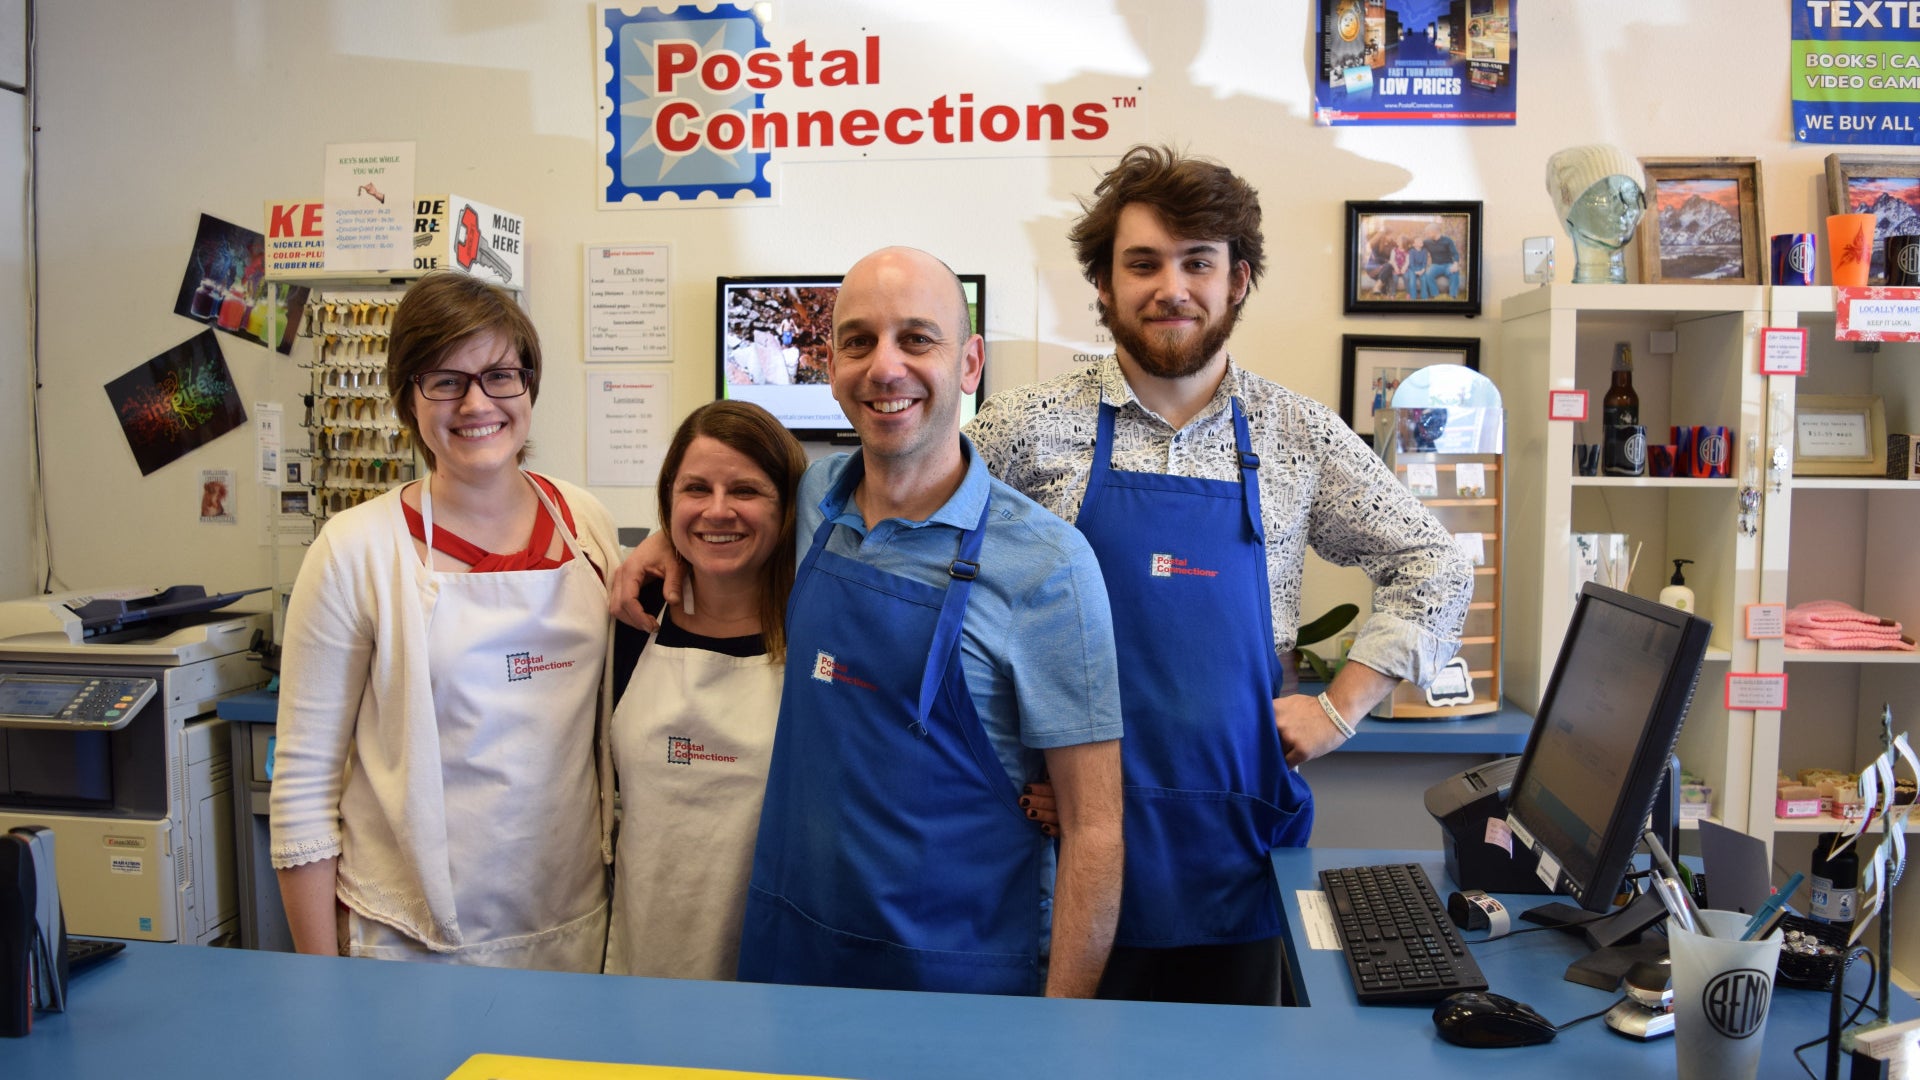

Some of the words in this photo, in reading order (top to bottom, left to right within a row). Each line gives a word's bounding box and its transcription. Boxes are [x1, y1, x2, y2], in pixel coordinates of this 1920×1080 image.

[657, 36, 880, 92] Postal
[1806, 54, 1878, 68] BOOKS
[1388, 68, 1404, 77] FAST
[1406, 68, 1424, 77] TURN
[1425, 68, 1453, 77] AROUND
[1380, 77, 1409, 95] LOW
[1413, 77, 1461, 95] PRICES
[1806, 75, 1864, 88] VIDEO
[655, 93, 1109, 152] Connections
[1805, 115, 1834, 130] WE
[1839, 116, 1877, 131] BUY
[1881, 116, 1914, 131] ALL
[339, 157, 357, 165] KEYS
[359, 156, 378, 164] MADE
[379, 155, 400, 163] WHILE
[353, 167, 366, 175] YOU
[368, 166, 385, 175] WAIT
[413, 200, 445, 214] DE
[269, 204, 324, 238] KE
[414, 218, 440, 232] RE
[493, 213, 521, 235] MADE
[492, 234, 519, 254] HERE
[413, 257, 437, 269] OLE
[1859, 305, 1896, 313] LOCALLY
[1897, 305, 1920, 313] MADE
[1073, 354, 1103, 362] COLOR
[1157, 556, 1187, 566] Postal
[1157, 565, 1216, 577] Connections
[514, 655, 543, 666] Postal
[515, 661, 573, 674] Connections
[674, 741, 704, 752] Postal
[674, 750, 735, 763] Connections
[1706, 972, 1769, 1036] BEND
